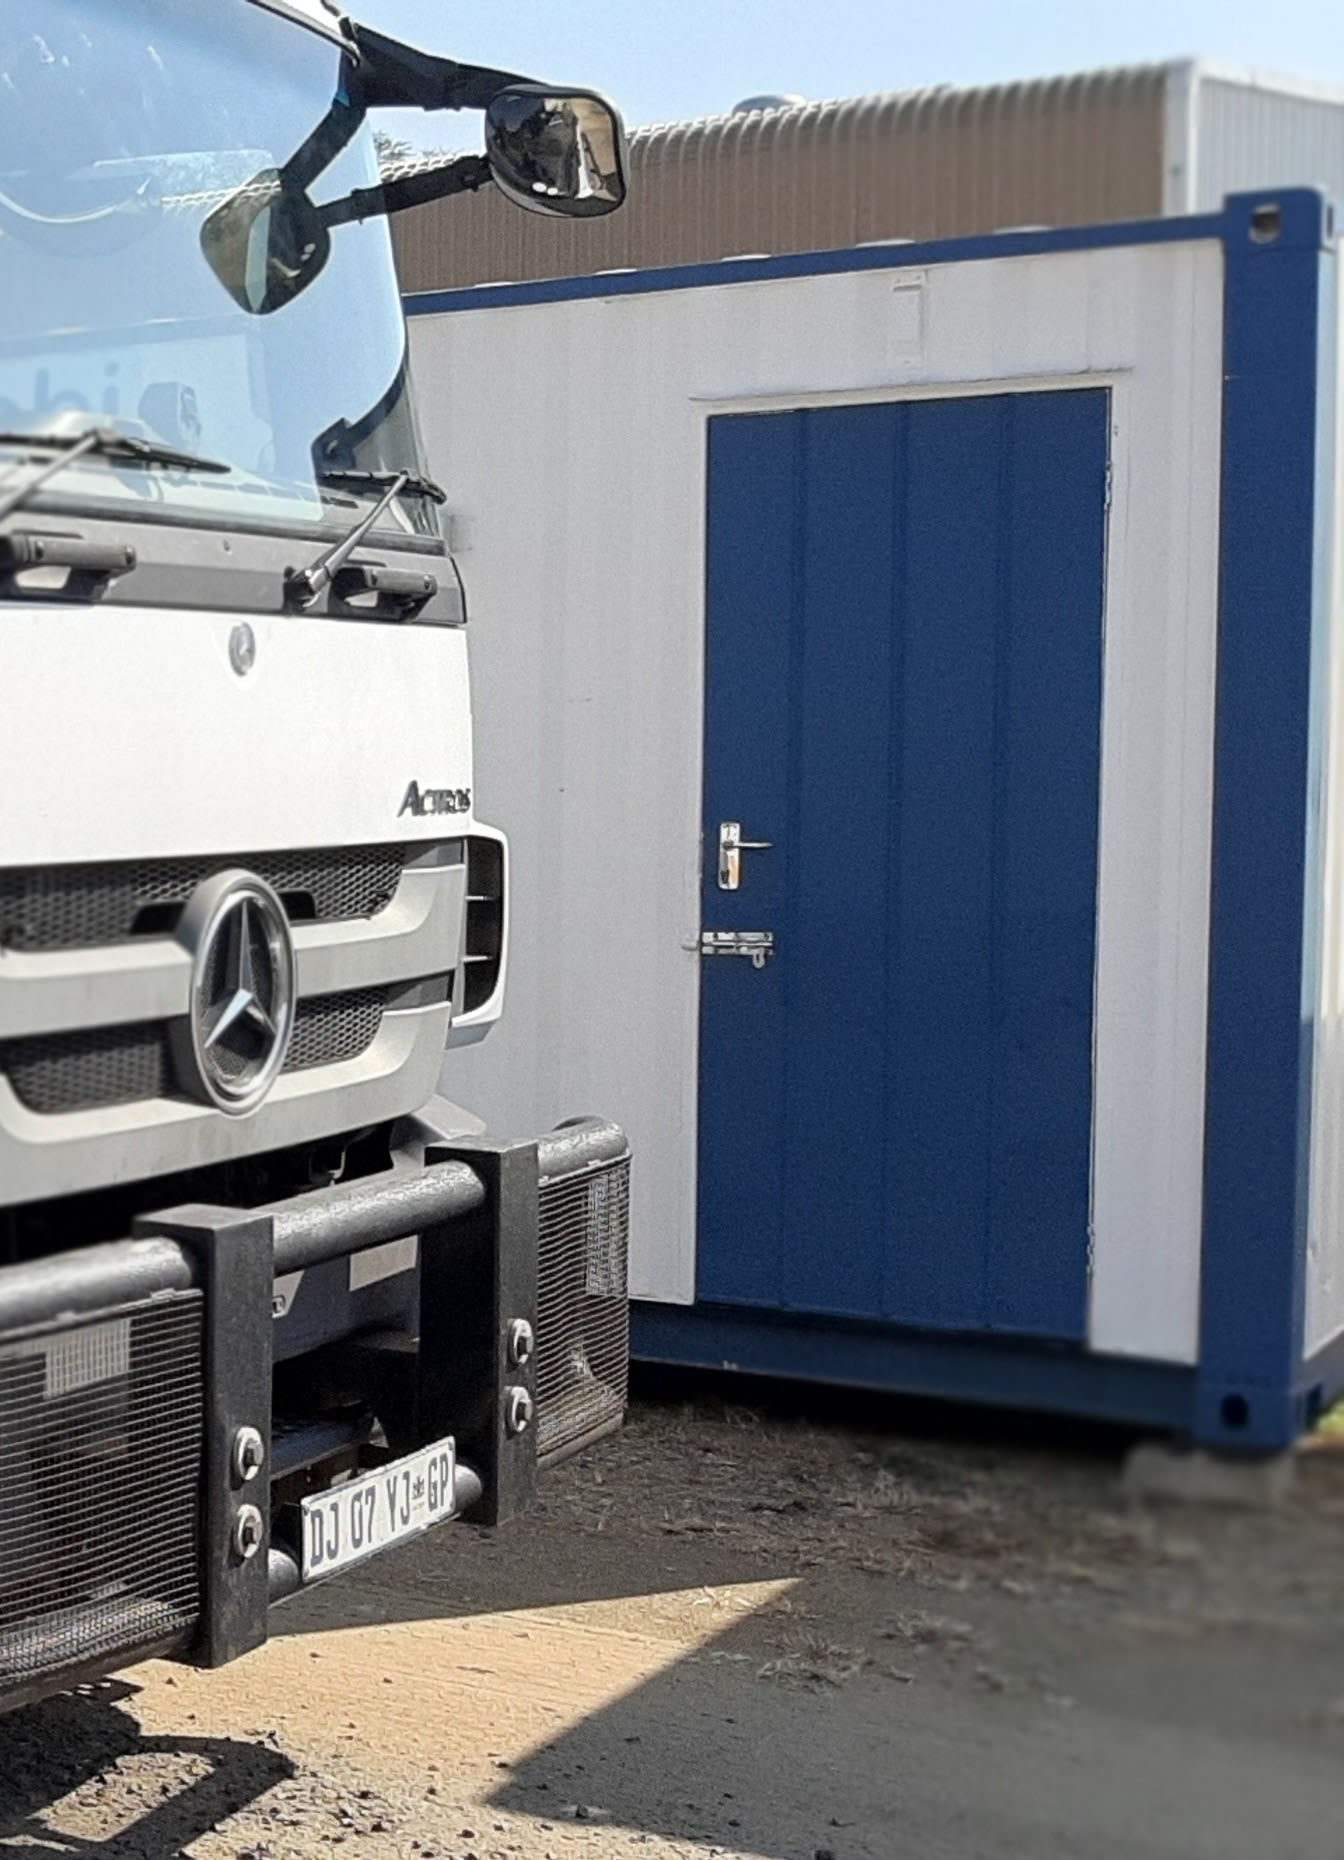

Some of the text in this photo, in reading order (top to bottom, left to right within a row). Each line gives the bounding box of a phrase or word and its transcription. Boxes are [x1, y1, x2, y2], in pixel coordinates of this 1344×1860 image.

[310, 1452, 450, 1568] DJ 07 YJ GP
